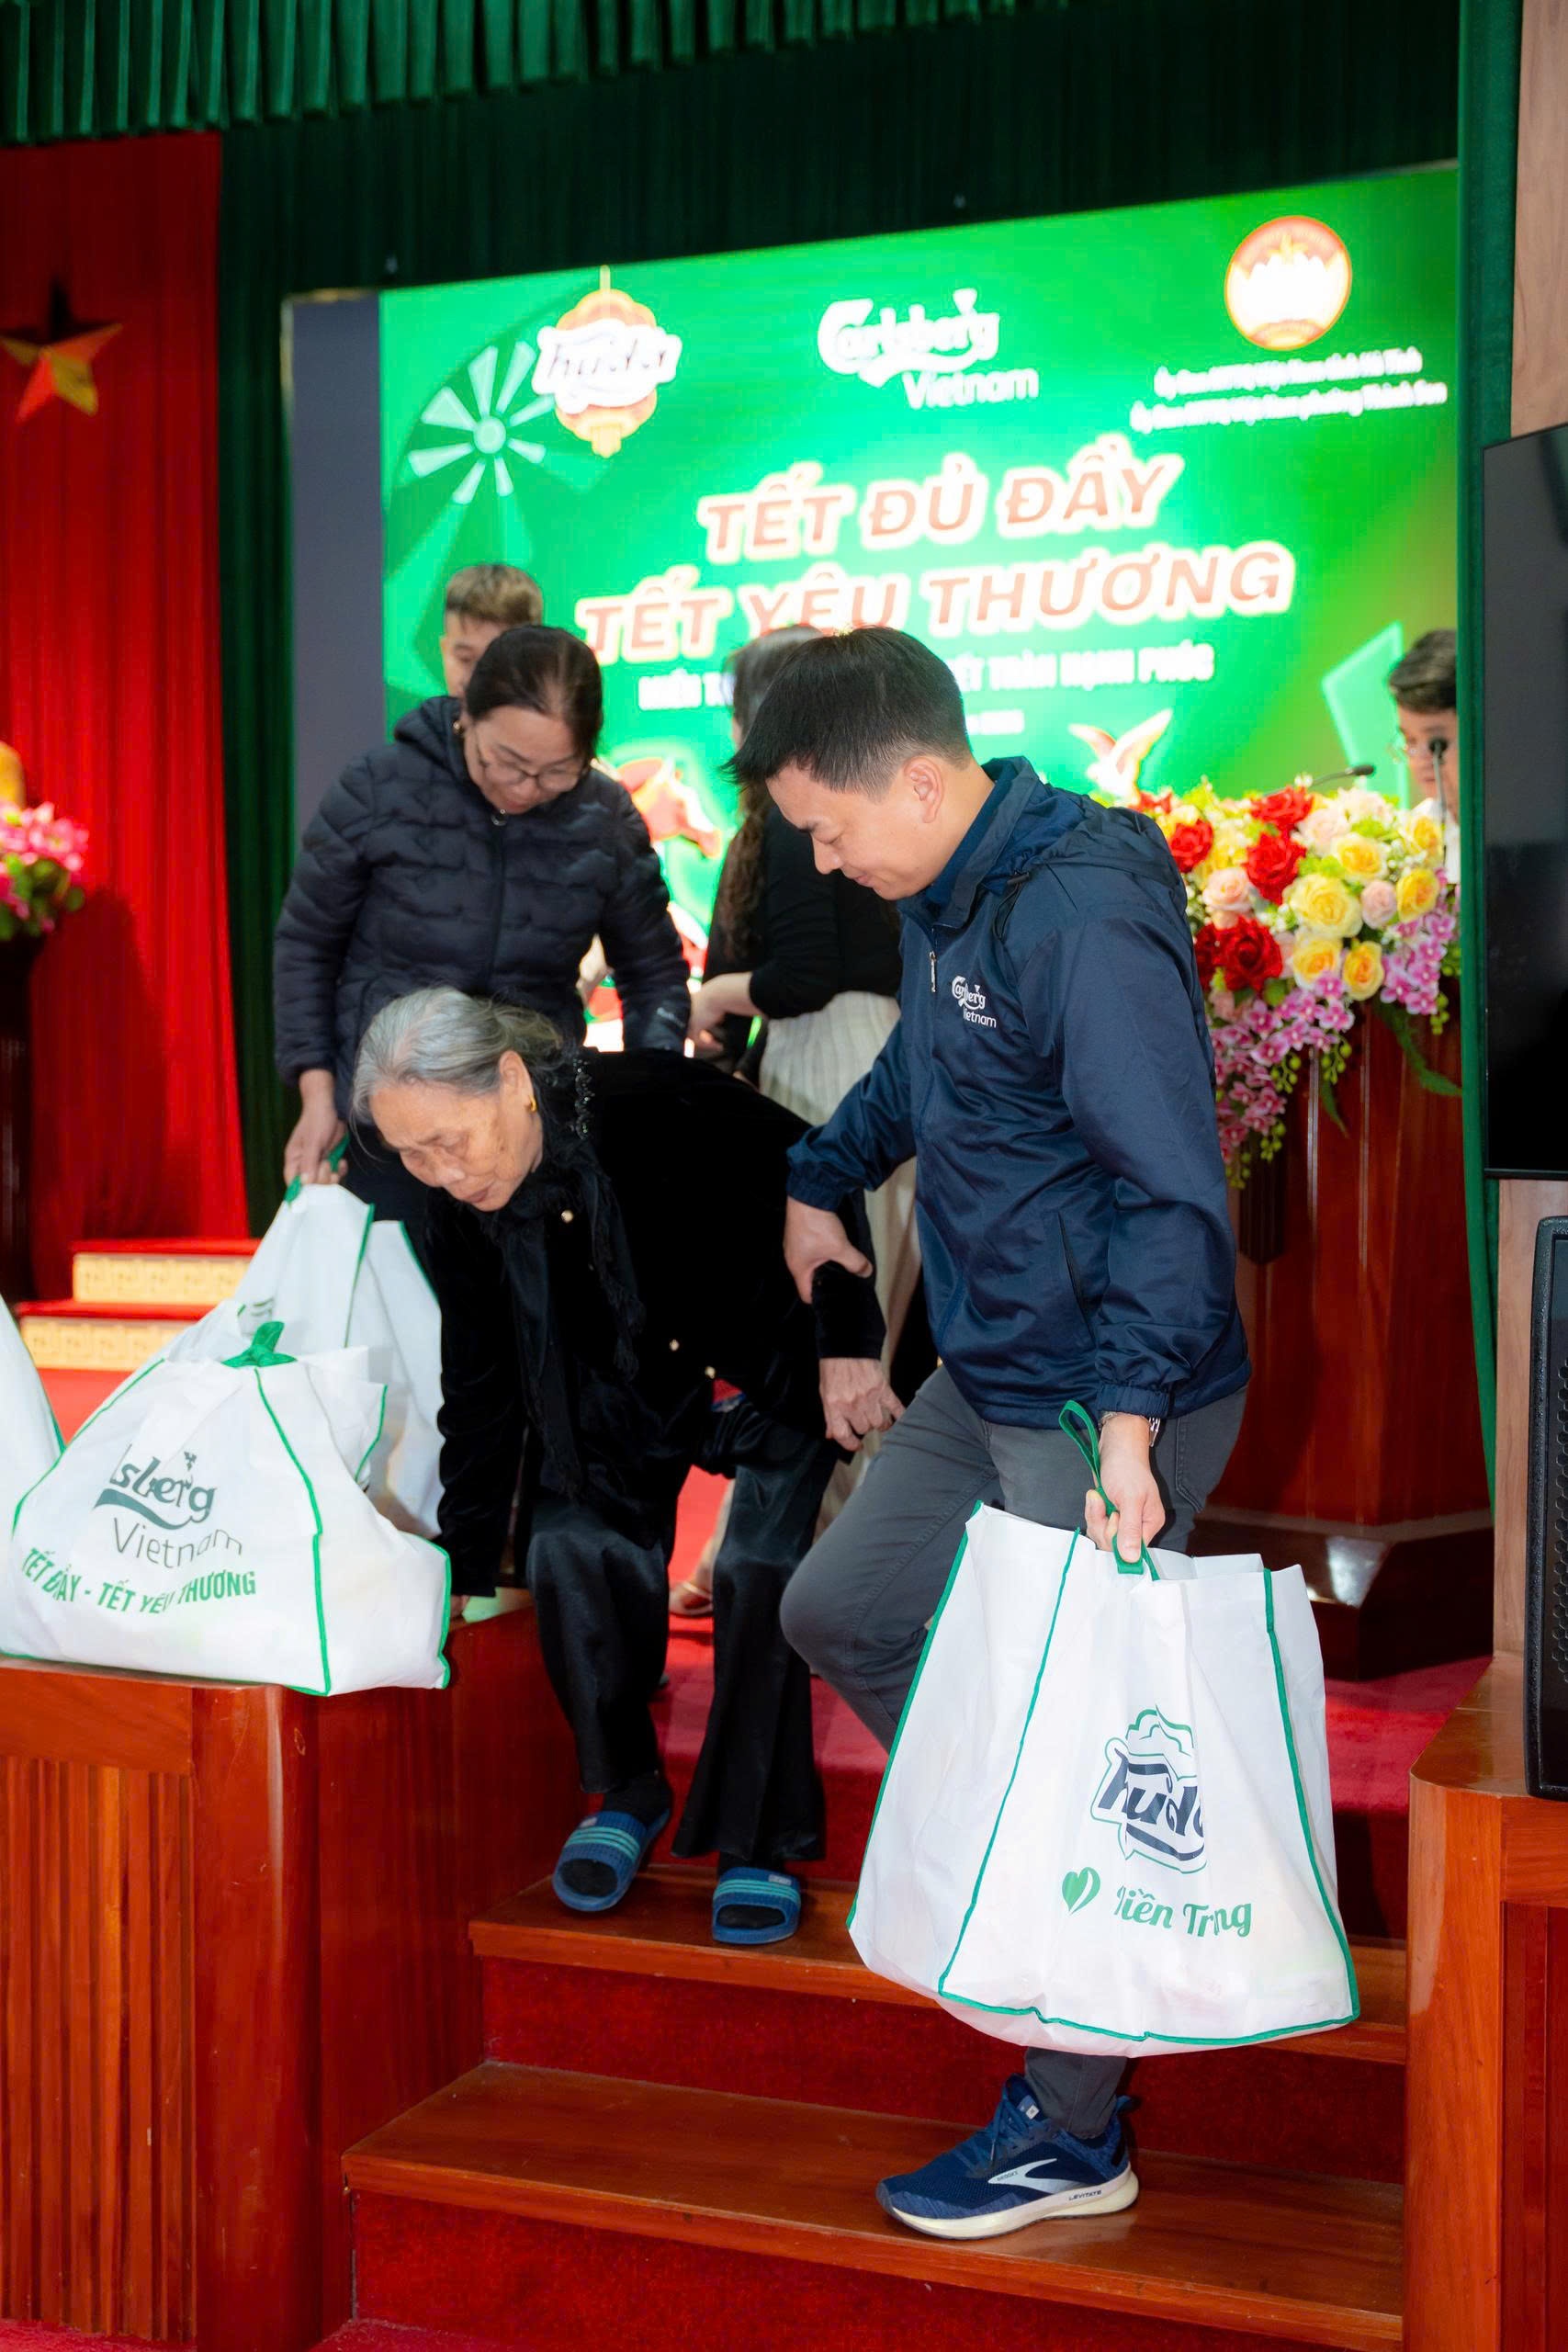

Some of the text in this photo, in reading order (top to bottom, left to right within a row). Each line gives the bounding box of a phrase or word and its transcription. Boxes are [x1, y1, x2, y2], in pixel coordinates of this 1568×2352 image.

[902, 368, 1039, 410] Vietnam
[702, 465, 847, 557] TẾT
[580, 570, 727, 657] TẾT
[924, 544, 1288, 632] THƯƠNG
[963, 1007, 997, 1028] ietnam
[114, 1517, 243, 1569] Vietnam
[97, 1578, 136, 1611] TẾT
[1183, 1903, 1252, 1938] Trng
